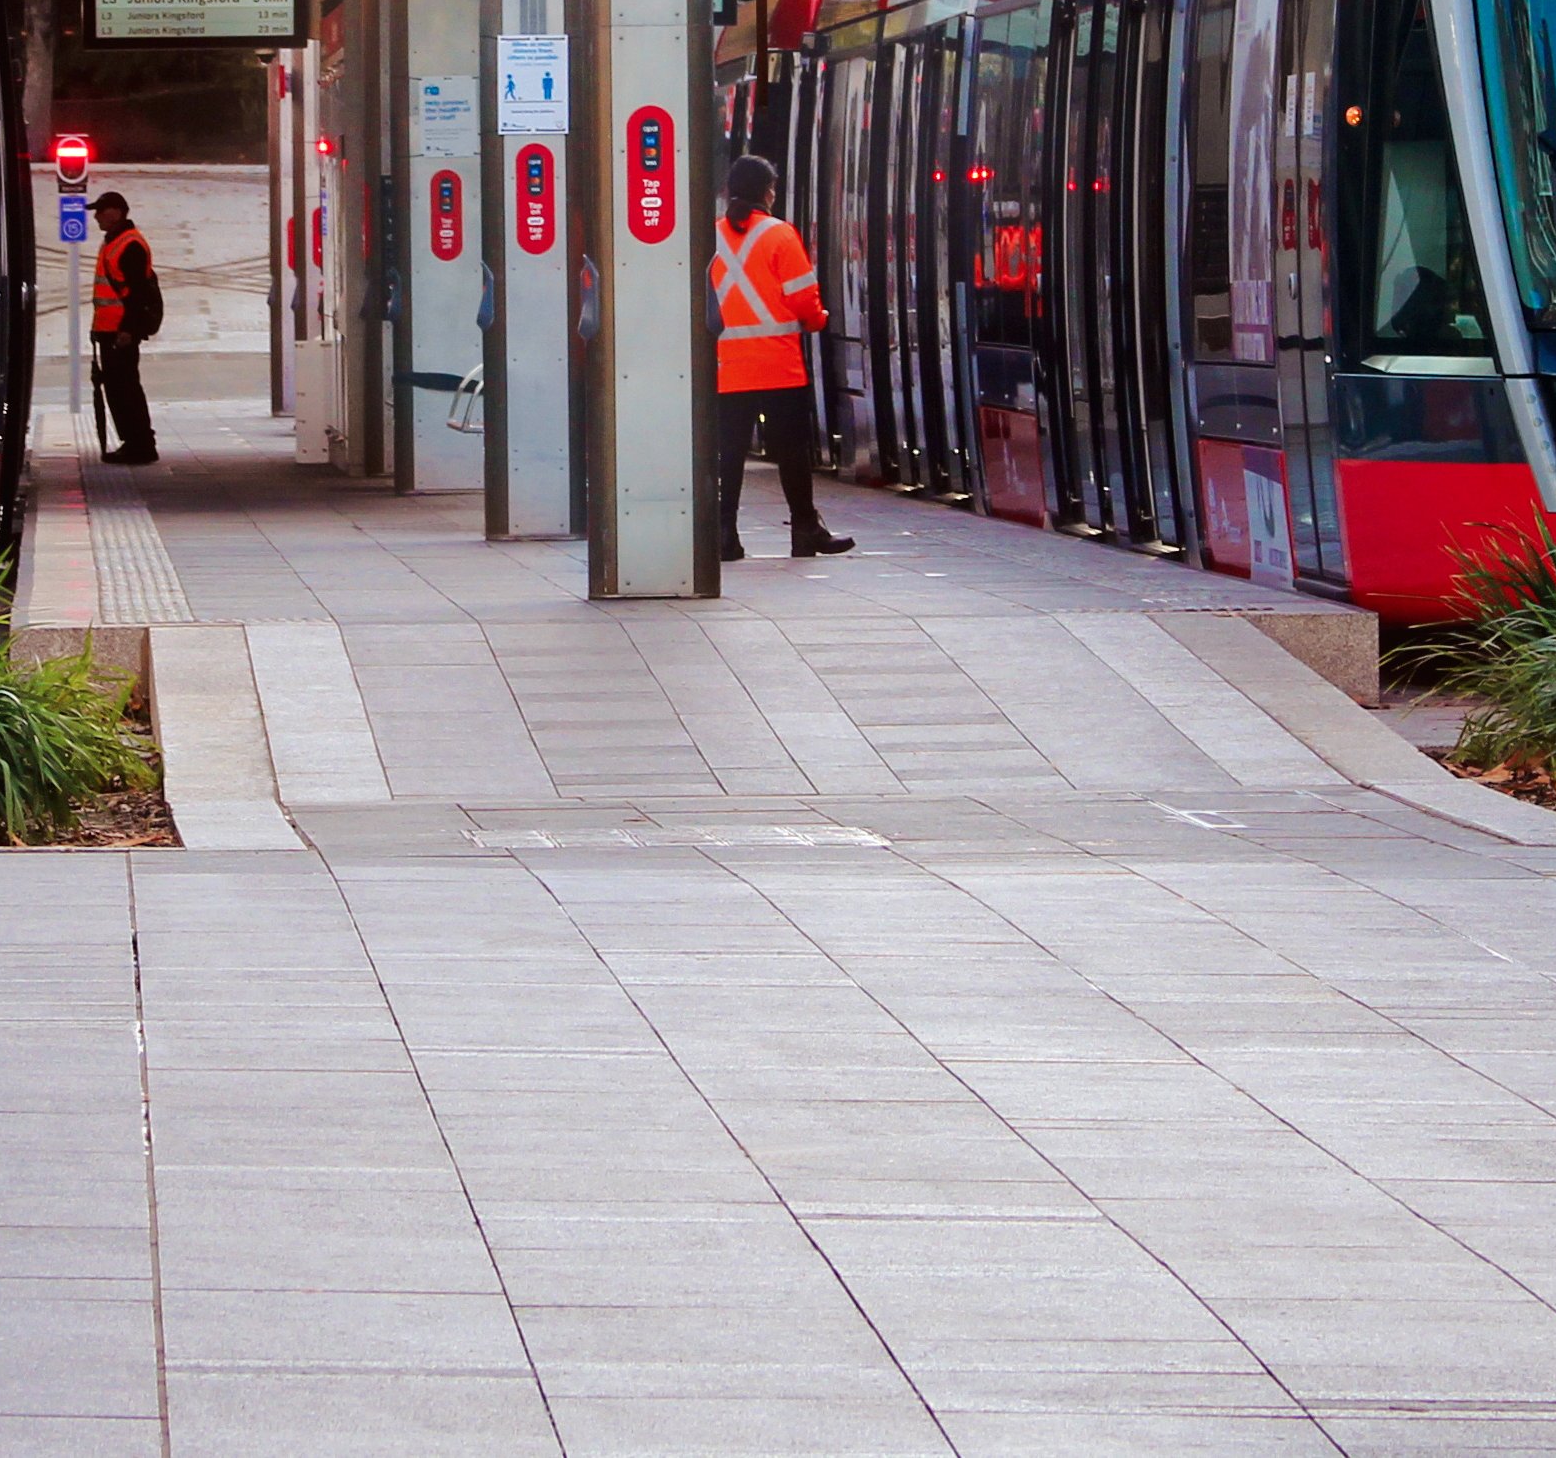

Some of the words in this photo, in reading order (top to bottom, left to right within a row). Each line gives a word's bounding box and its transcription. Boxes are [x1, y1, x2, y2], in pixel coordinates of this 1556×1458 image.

[127, 12, 160, 20] Juniors
[162, 11, 205, 21] Kingsford
[272, 11, 288, 19] min
[127, 26, 160, 35] Juniors
[162, 26, 205, 36] Kingsford
[272, 25, 288, 33] min
[642, 179, 660, 188] Tap
[645, 187, 658, 195] on
[643, 209, 660, 218] tap
[644, 218, 659, 226] off
